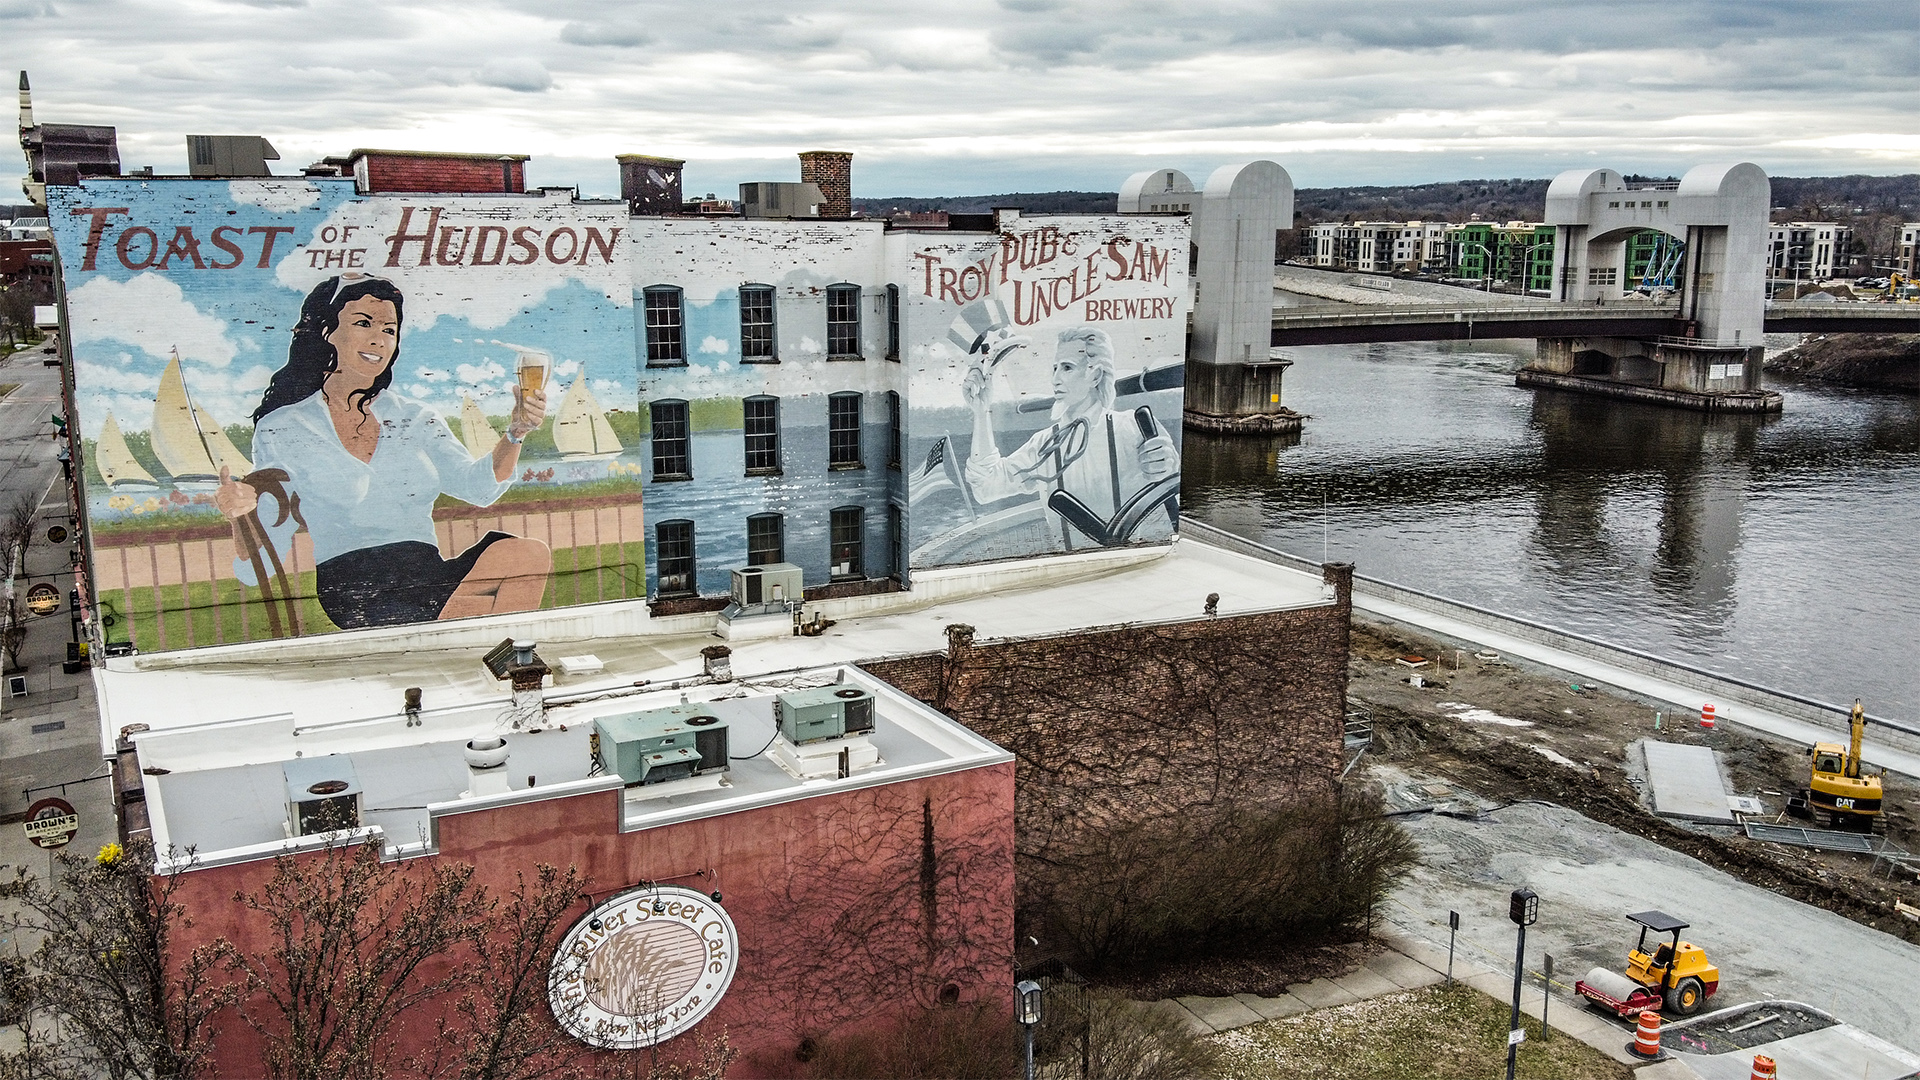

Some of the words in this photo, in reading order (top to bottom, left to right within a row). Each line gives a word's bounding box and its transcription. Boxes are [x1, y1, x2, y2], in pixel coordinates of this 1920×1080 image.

[70, 207, 295, 272] TOAST
[321, 225, 360, 244] OF
[383, 206, 625, 268] HUDSON
[305, 248, 368, 269] THE
[914, 251, 997, 306] TROY
[1000, 226, 1059, 286] PUB
[1012, 248, 1102, 326] UNCLE
[1106, 235, 1170, 288] SAM
[1085, 296, 1178, 322] BREWERY
[1836, 798, 1855, 809] CAT
[25, 816, 76, 831] BROWN'S
[635, 899, 705, 923] Street
[637, 1015, 668, 1035] New
[669, 995, 702, 1022] York
